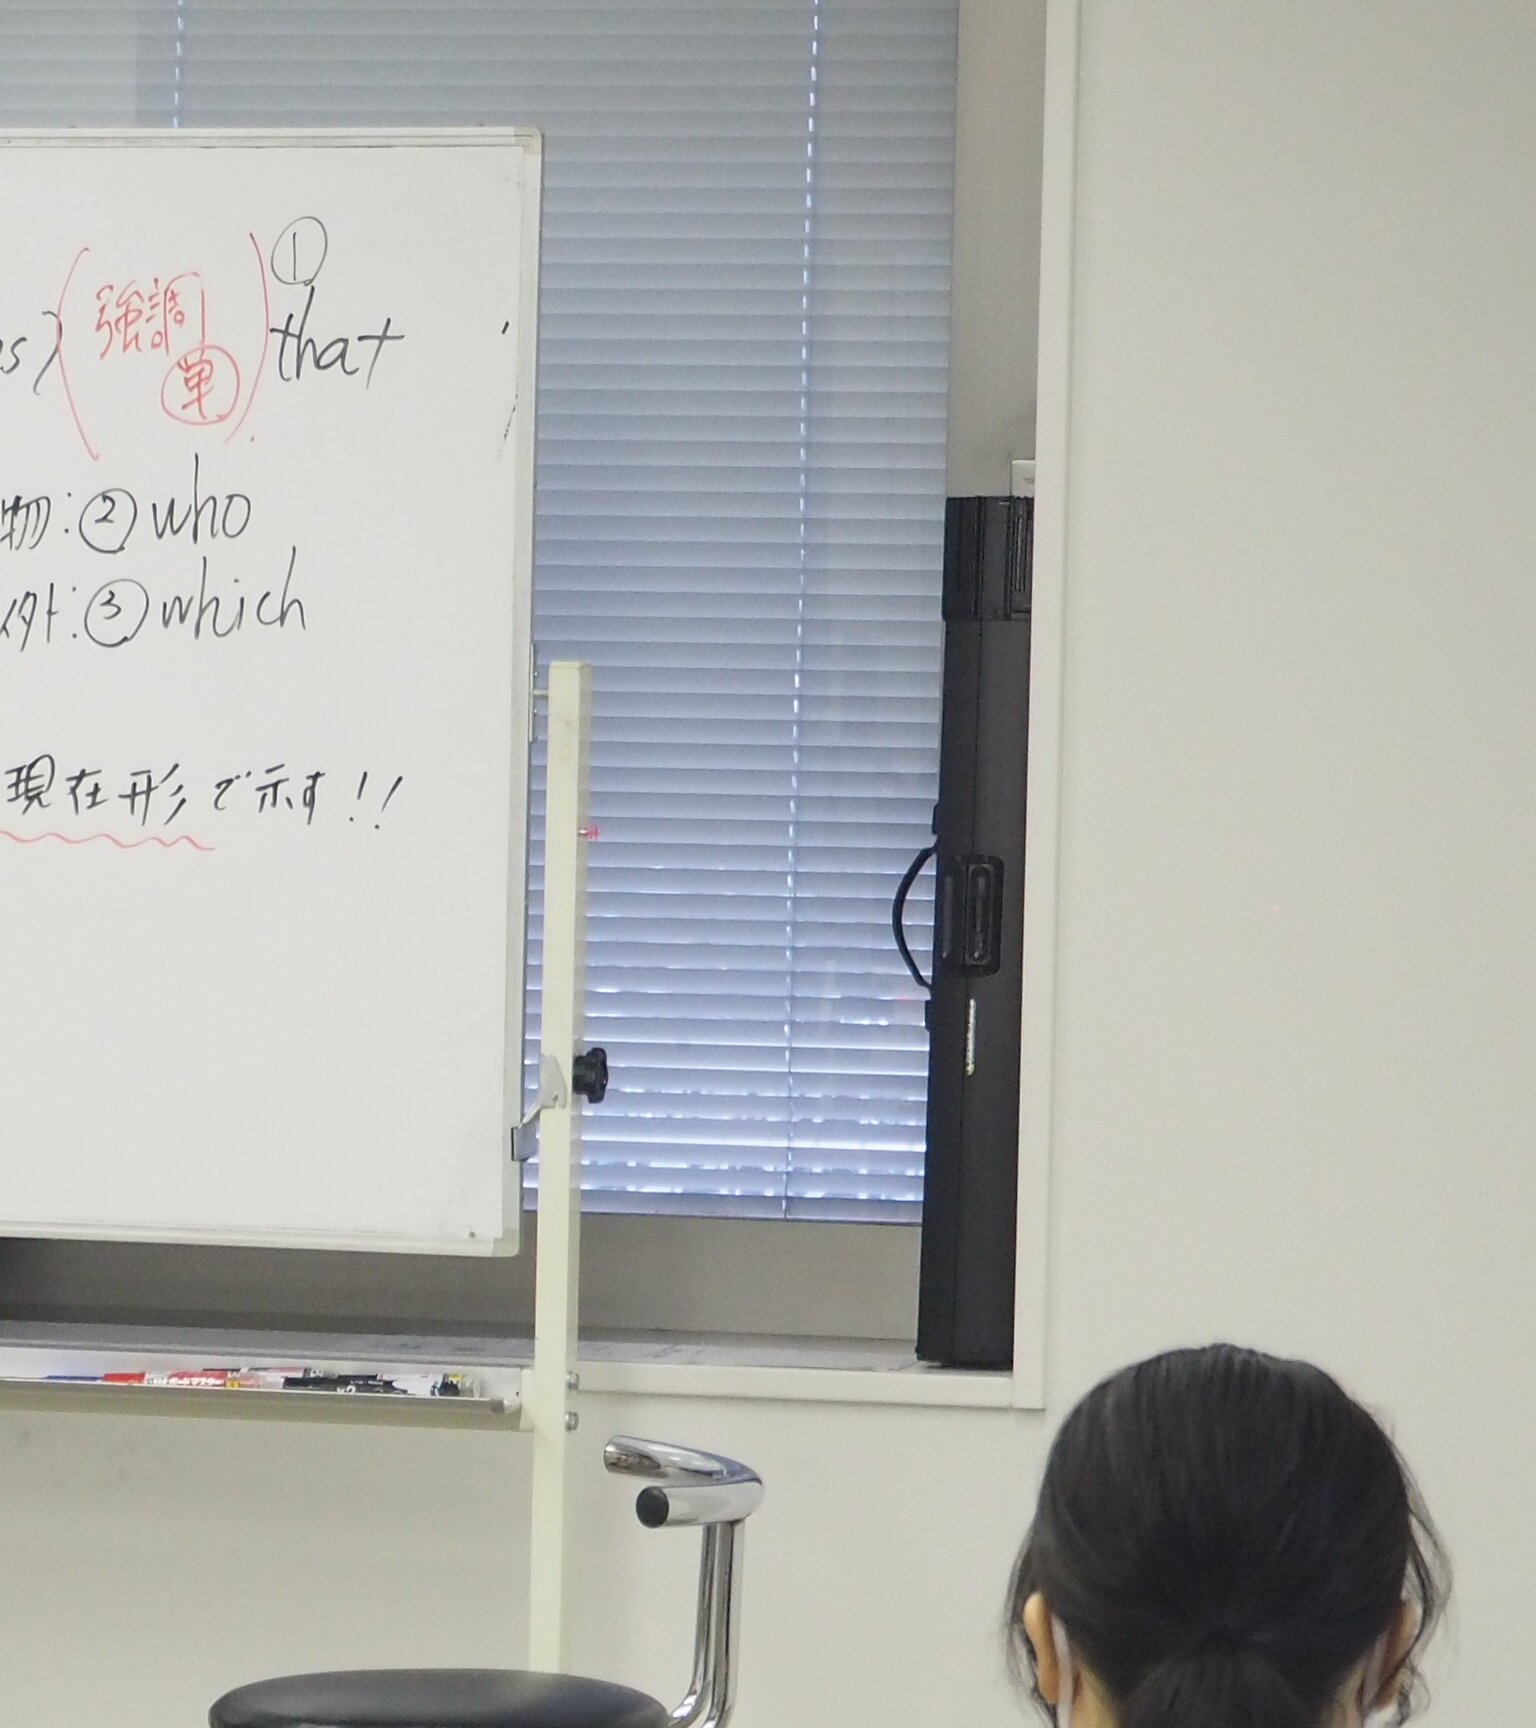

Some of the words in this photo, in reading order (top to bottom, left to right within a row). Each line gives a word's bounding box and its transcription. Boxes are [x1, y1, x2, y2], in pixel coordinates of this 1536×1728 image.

[269, 285, 406, 390] that
[151, 452, 252, 545] who
[161, 545, 307, 640] which
